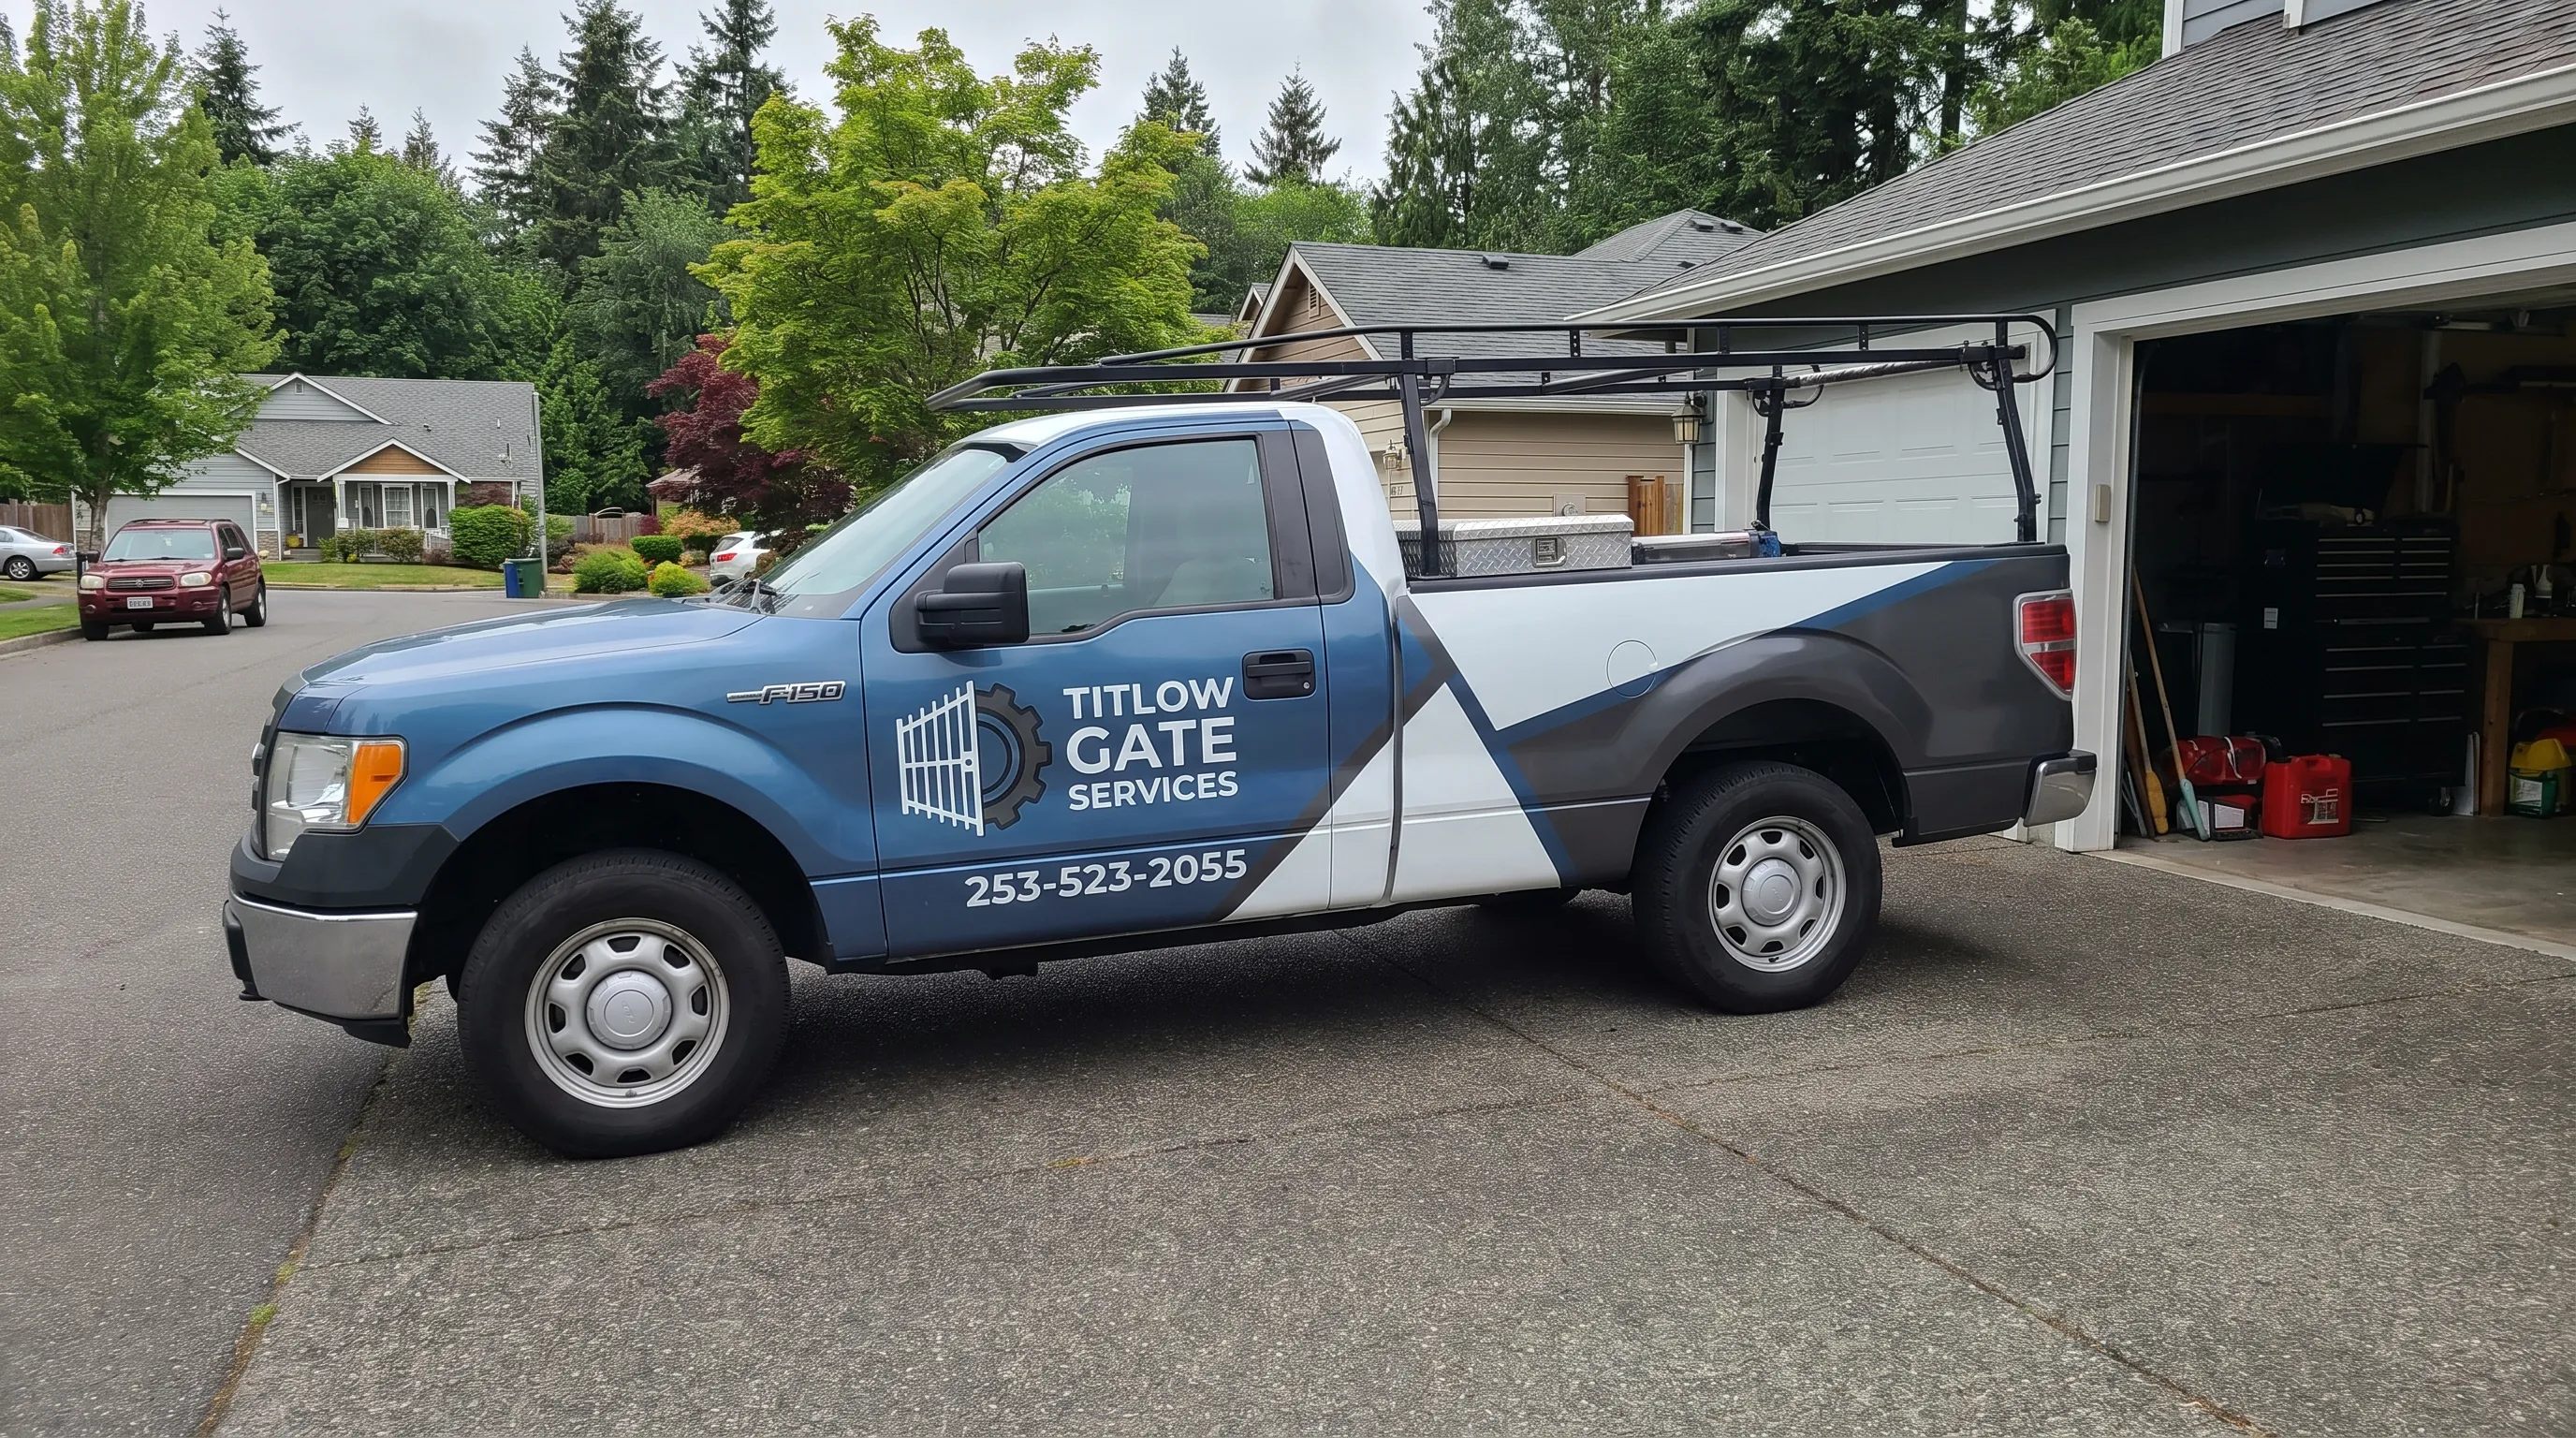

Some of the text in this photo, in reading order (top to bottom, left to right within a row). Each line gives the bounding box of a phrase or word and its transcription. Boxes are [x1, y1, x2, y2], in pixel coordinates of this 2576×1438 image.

[759, 681, 846, 705] F-150
[1062, 676, 1235, 720] TITLOW
[1066, 716, 1237, 774] GATE
[1068, 770, 1239, 811] SERVICES
[964, 848, 1247, 908] 253-523-2055
